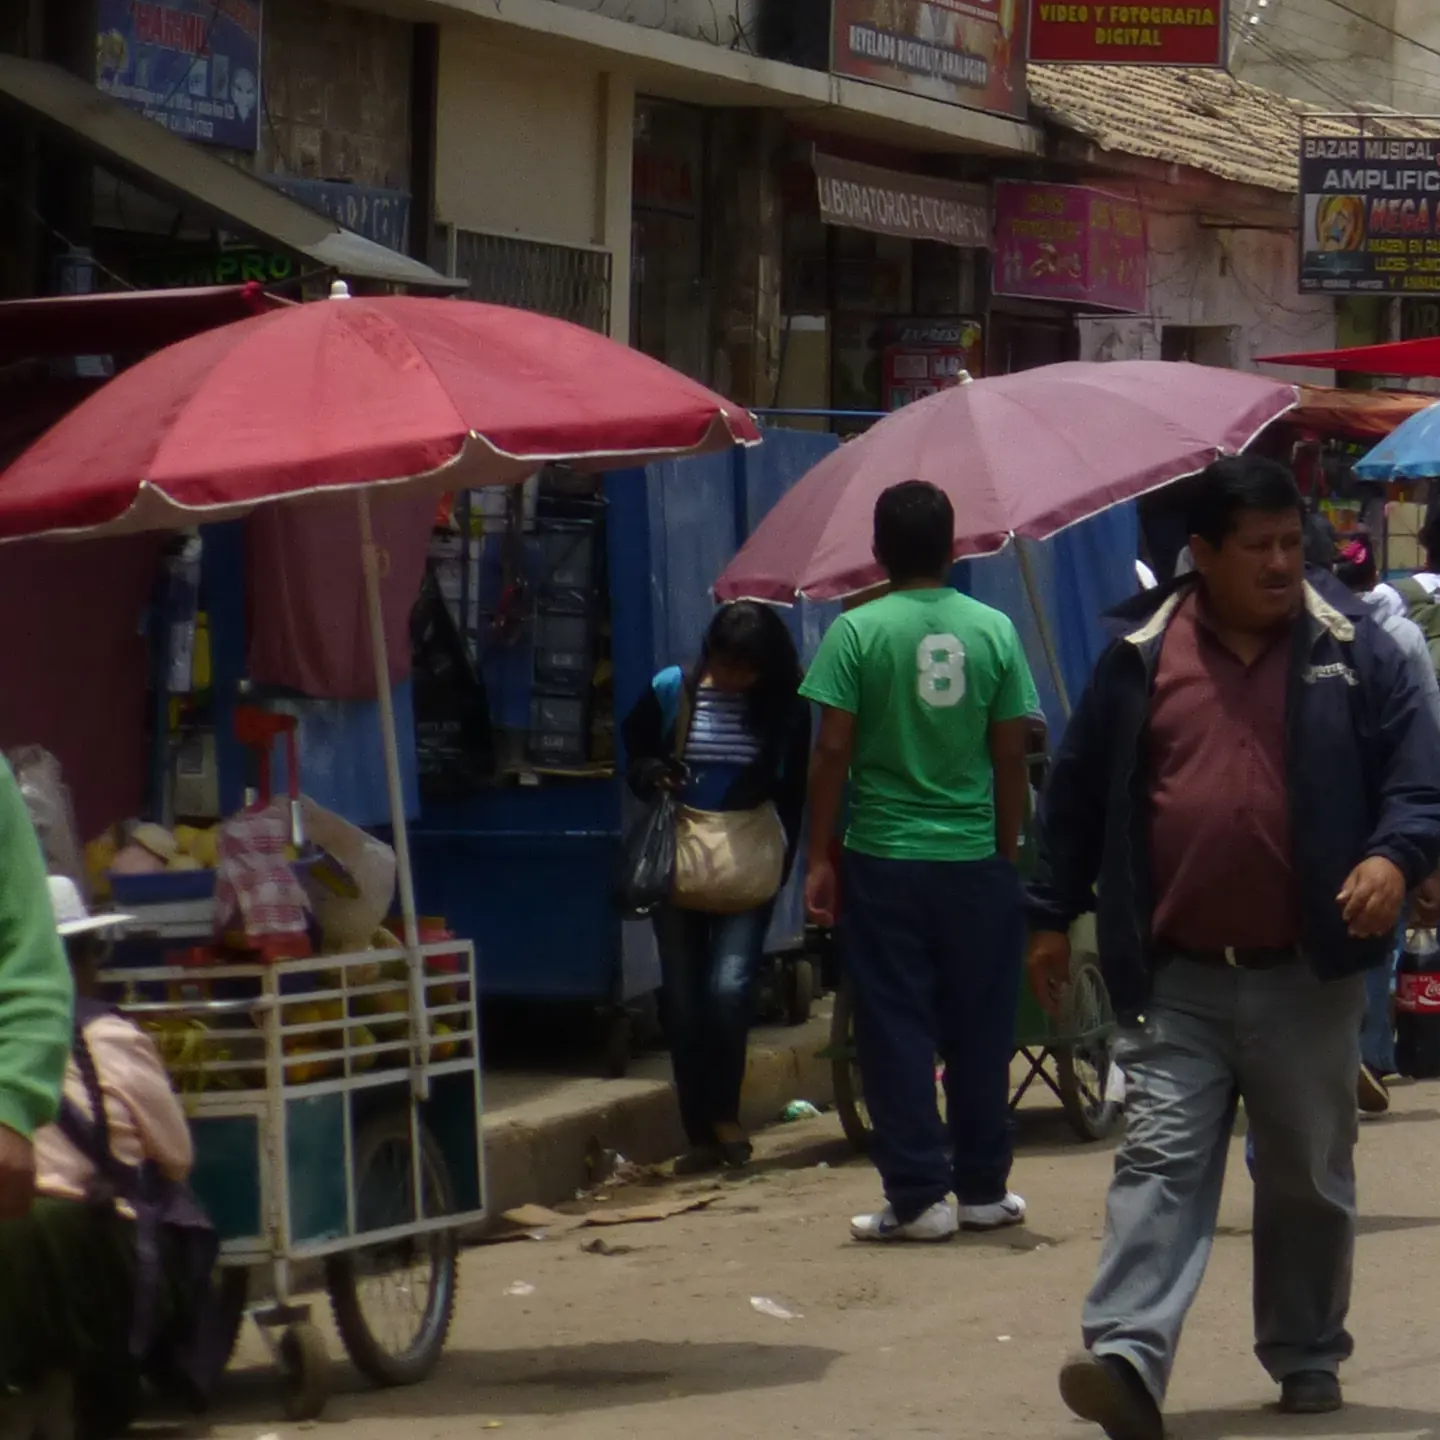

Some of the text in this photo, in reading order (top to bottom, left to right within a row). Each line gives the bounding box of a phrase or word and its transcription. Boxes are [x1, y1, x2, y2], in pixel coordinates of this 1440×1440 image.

[1039, 4, 1089, 22] VIDEO
[1093, 5, 1106, 23] Y
[1094, 28, 1163, 46] DIGITAL
[1304, 140, 1361, 160] BAZAR
[1364, 141, 1436, 161] MUSICAL
[1368, 197, 1430, 235] MEGA
[916, 633, 966, 708] 8
